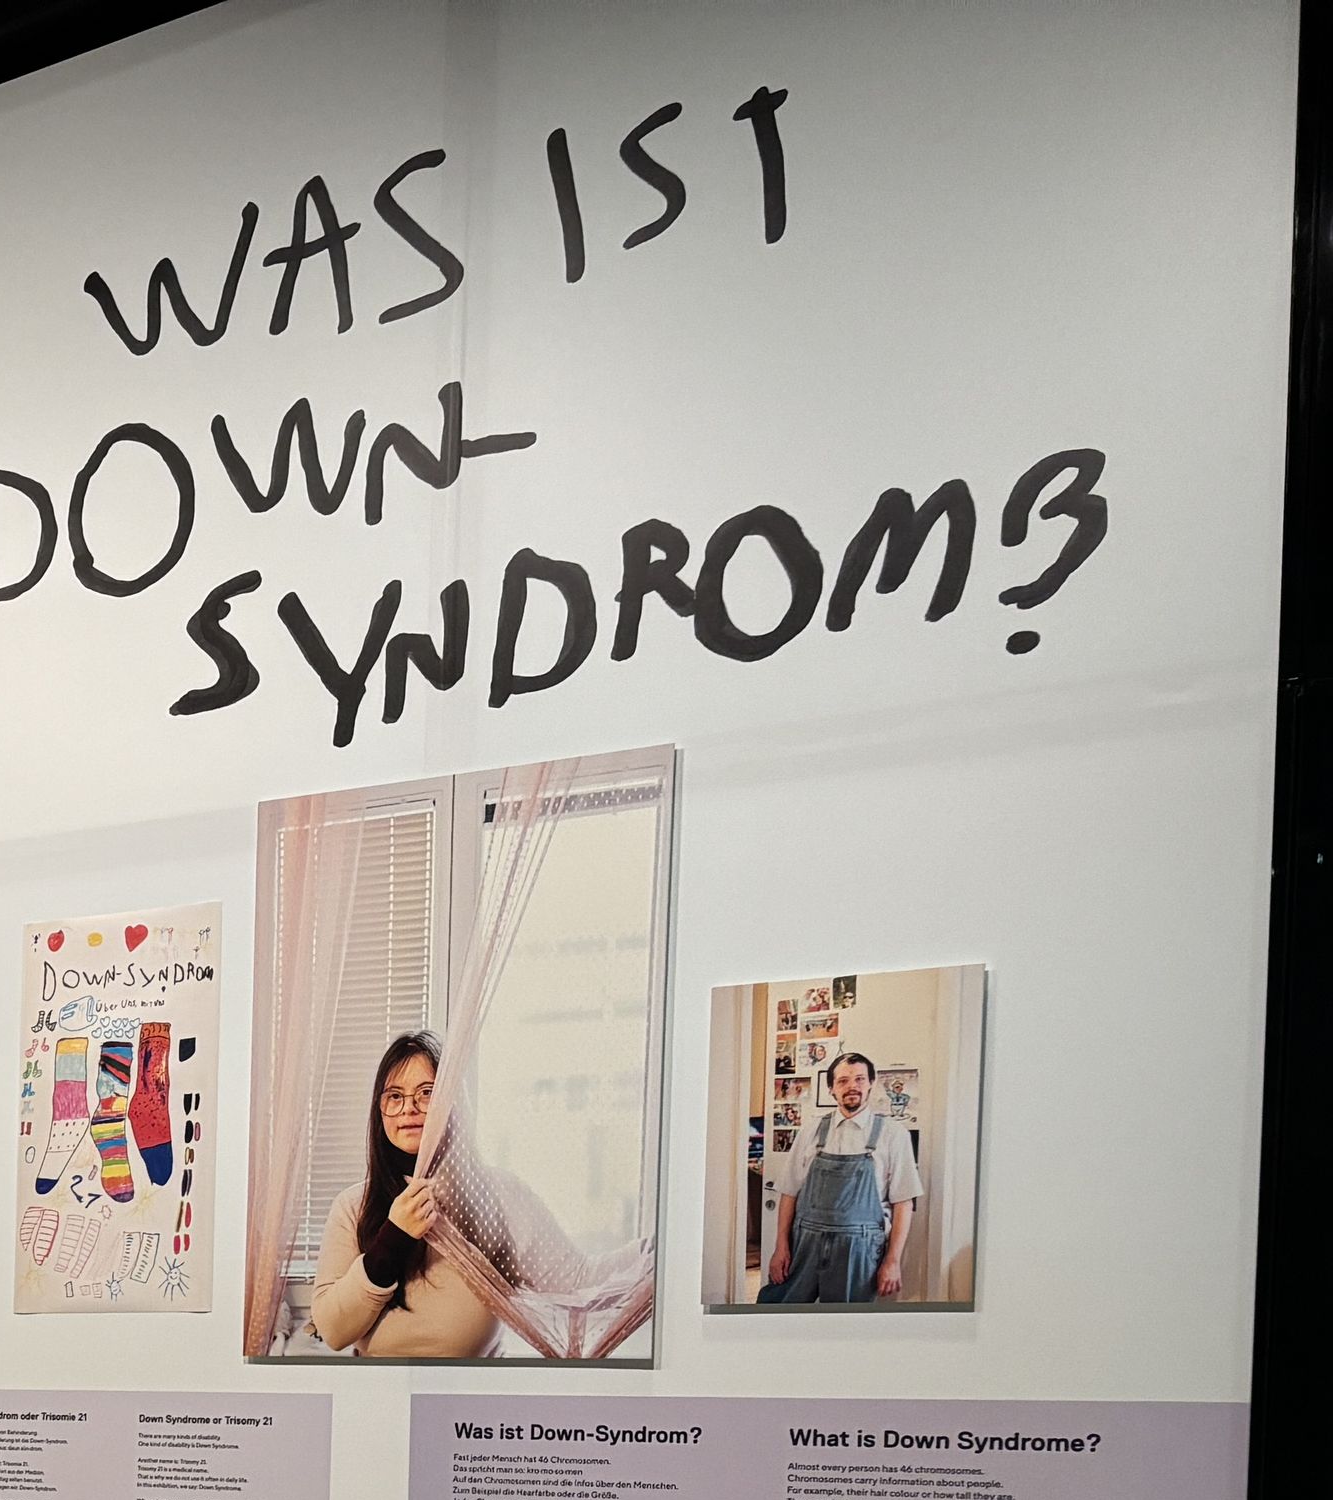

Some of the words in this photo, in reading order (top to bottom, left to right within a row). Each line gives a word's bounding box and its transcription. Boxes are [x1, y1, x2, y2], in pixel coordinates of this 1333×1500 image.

[84, 148, 465, 356] WAS
[547, 86, 789, 283] IST
[171, 447, 1107, 747] SYNDROM?
[20, 1412, 39, 1420] oder
[41, 1412, 76, 1421] Trisomie
[78, 1413, 87, 1421] 21
[139, 1414, 164, 1423] Down
[165, 1414, 211, 1425] Syndrome
[224, 1416, 261, 1427] Trisomy
[262, 1416, 273, 1426] 21
[454, 1422, 493, 1439] Was
[499, 1423, 524, 1440] ist
[530, 1424, 702, 1446] Down-Syndrom?
[789, 1428, 850, 1447] What
[856, 1429, 876, 1448] is
[883, 1430, 950, 1449] Down
[957, 1431, 1101, 1454] Syndrome?
